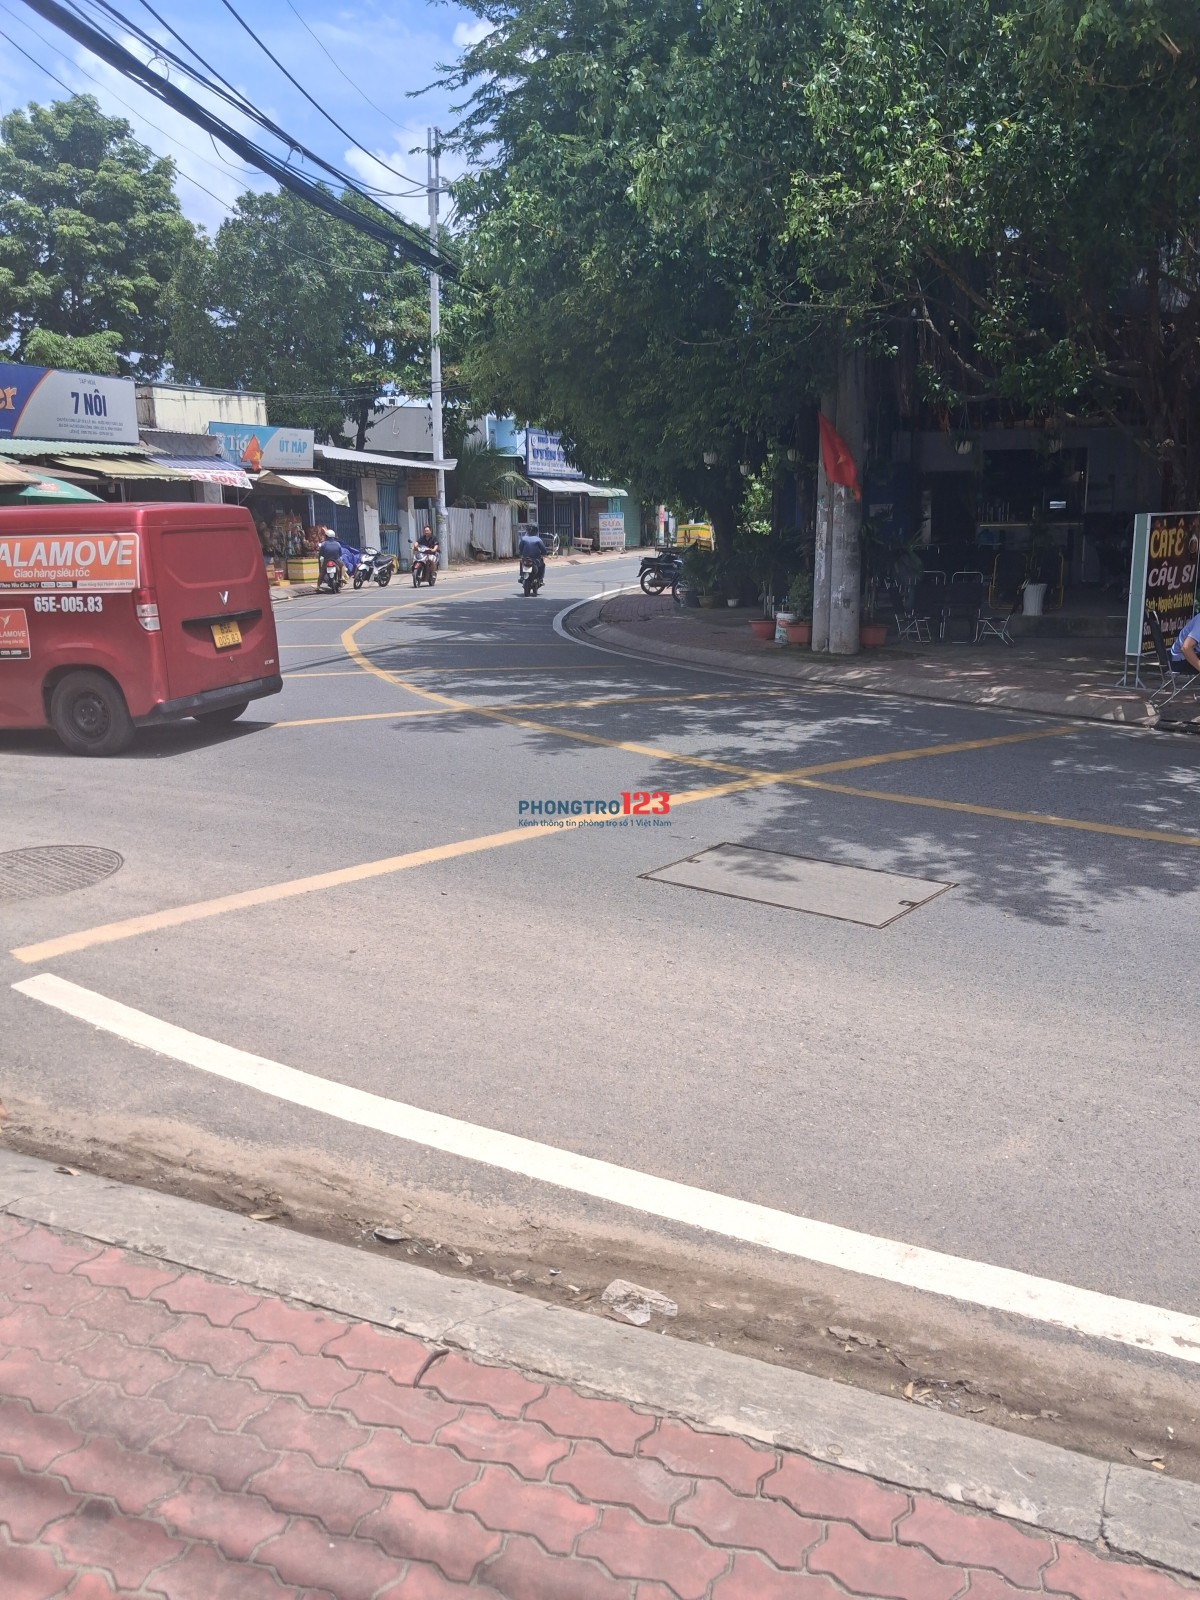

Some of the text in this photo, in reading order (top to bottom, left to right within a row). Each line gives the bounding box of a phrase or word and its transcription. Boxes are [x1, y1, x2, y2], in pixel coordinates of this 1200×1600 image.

[71, 389, 108, 417] 7 NÔI
[75, 566, 90, 577] tốc
[1148, 560, 1181, 590] CÂY
[34, 596, 103, 612] 65E-005.83
